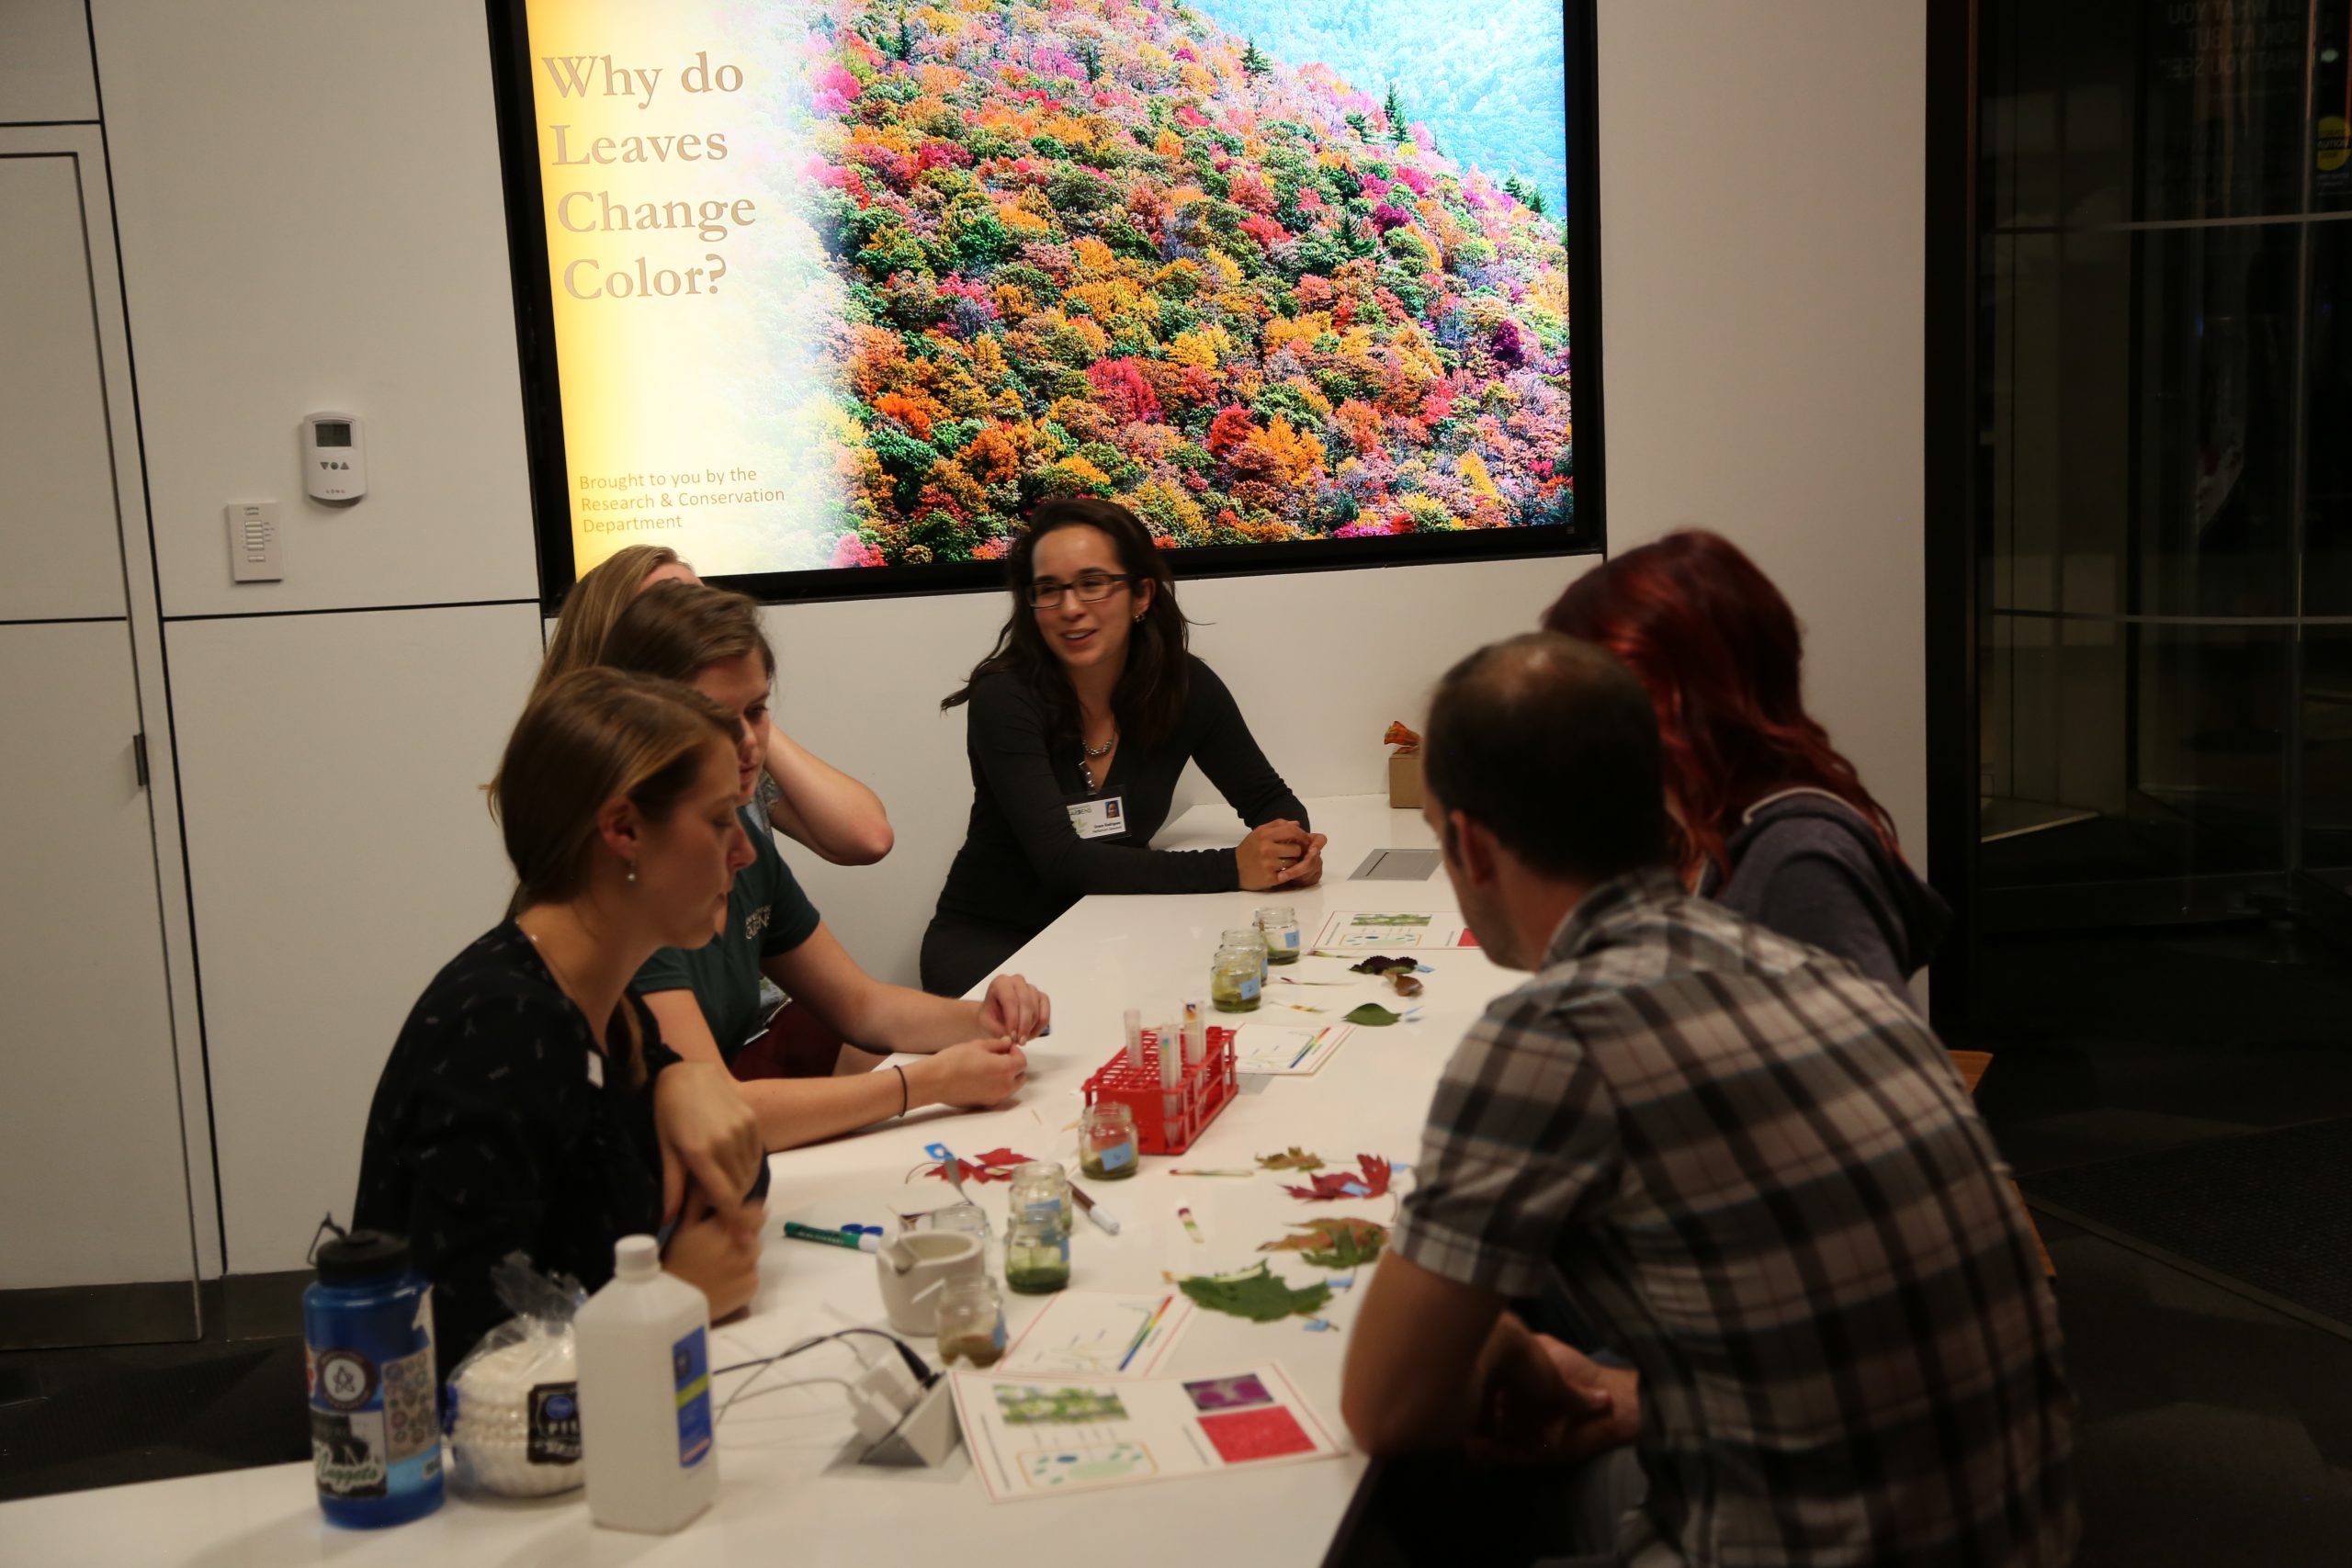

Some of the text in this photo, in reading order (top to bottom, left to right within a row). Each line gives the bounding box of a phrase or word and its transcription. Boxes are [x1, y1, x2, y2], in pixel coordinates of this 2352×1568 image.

[541, 51, 743, 109] Why do
[549, 124, 728, 165] Leaves
[558, 190, 756, 243] Change
[563, 253, 727, 299] Color?
[580, 467, 757, 491] Brought to you by the
[582, 488, 785, 512] Research & Conservation
[583, 514, 683, 535] Department
